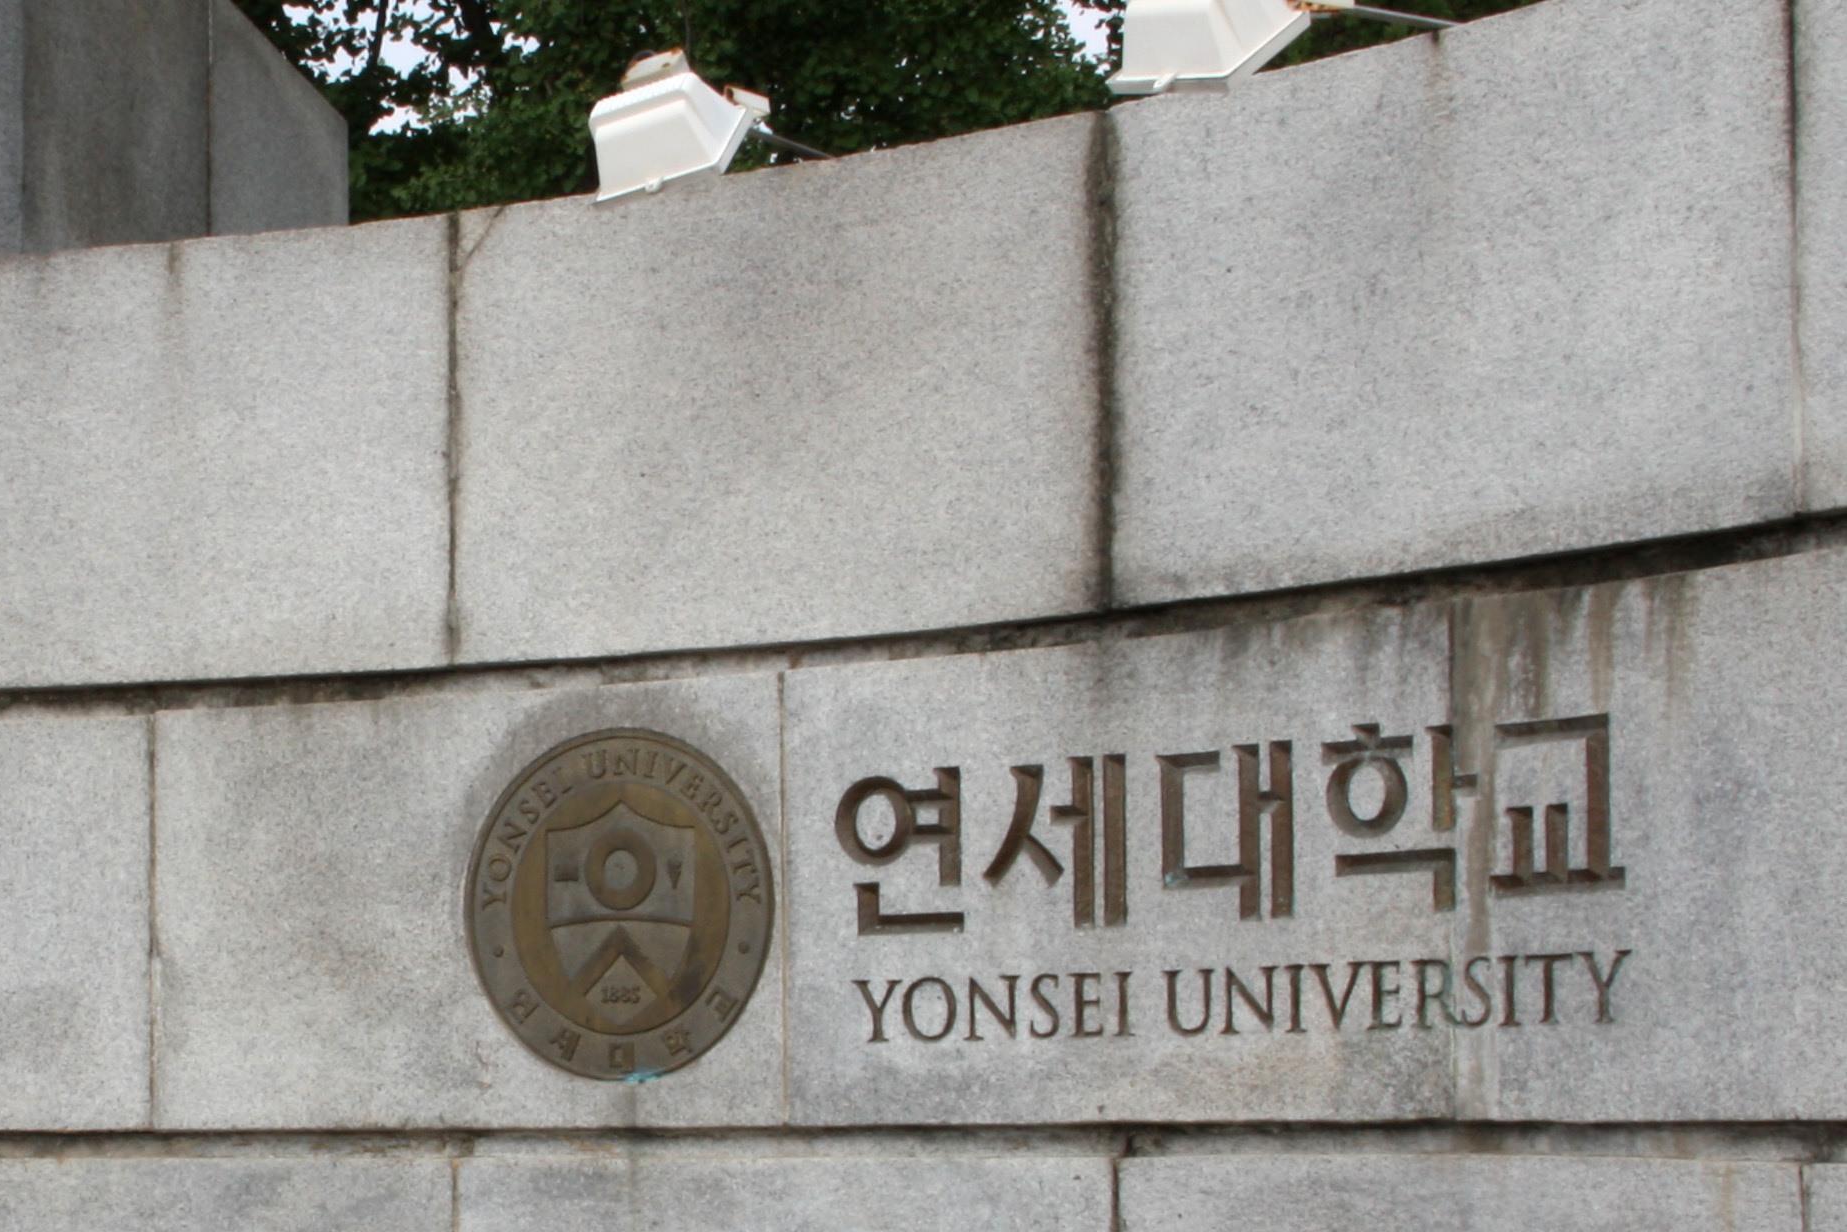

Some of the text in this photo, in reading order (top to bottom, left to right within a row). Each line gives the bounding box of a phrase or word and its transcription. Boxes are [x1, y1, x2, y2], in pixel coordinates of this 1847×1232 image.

[482, 747, 763, 912] YONSEI UNIVERSITY
[834, 711, 1627, 936] 연세대학교
[600, 984, 642, 1005] 1885
[853, 949, 1632, 1043] YONSEI UNIVERSITY
